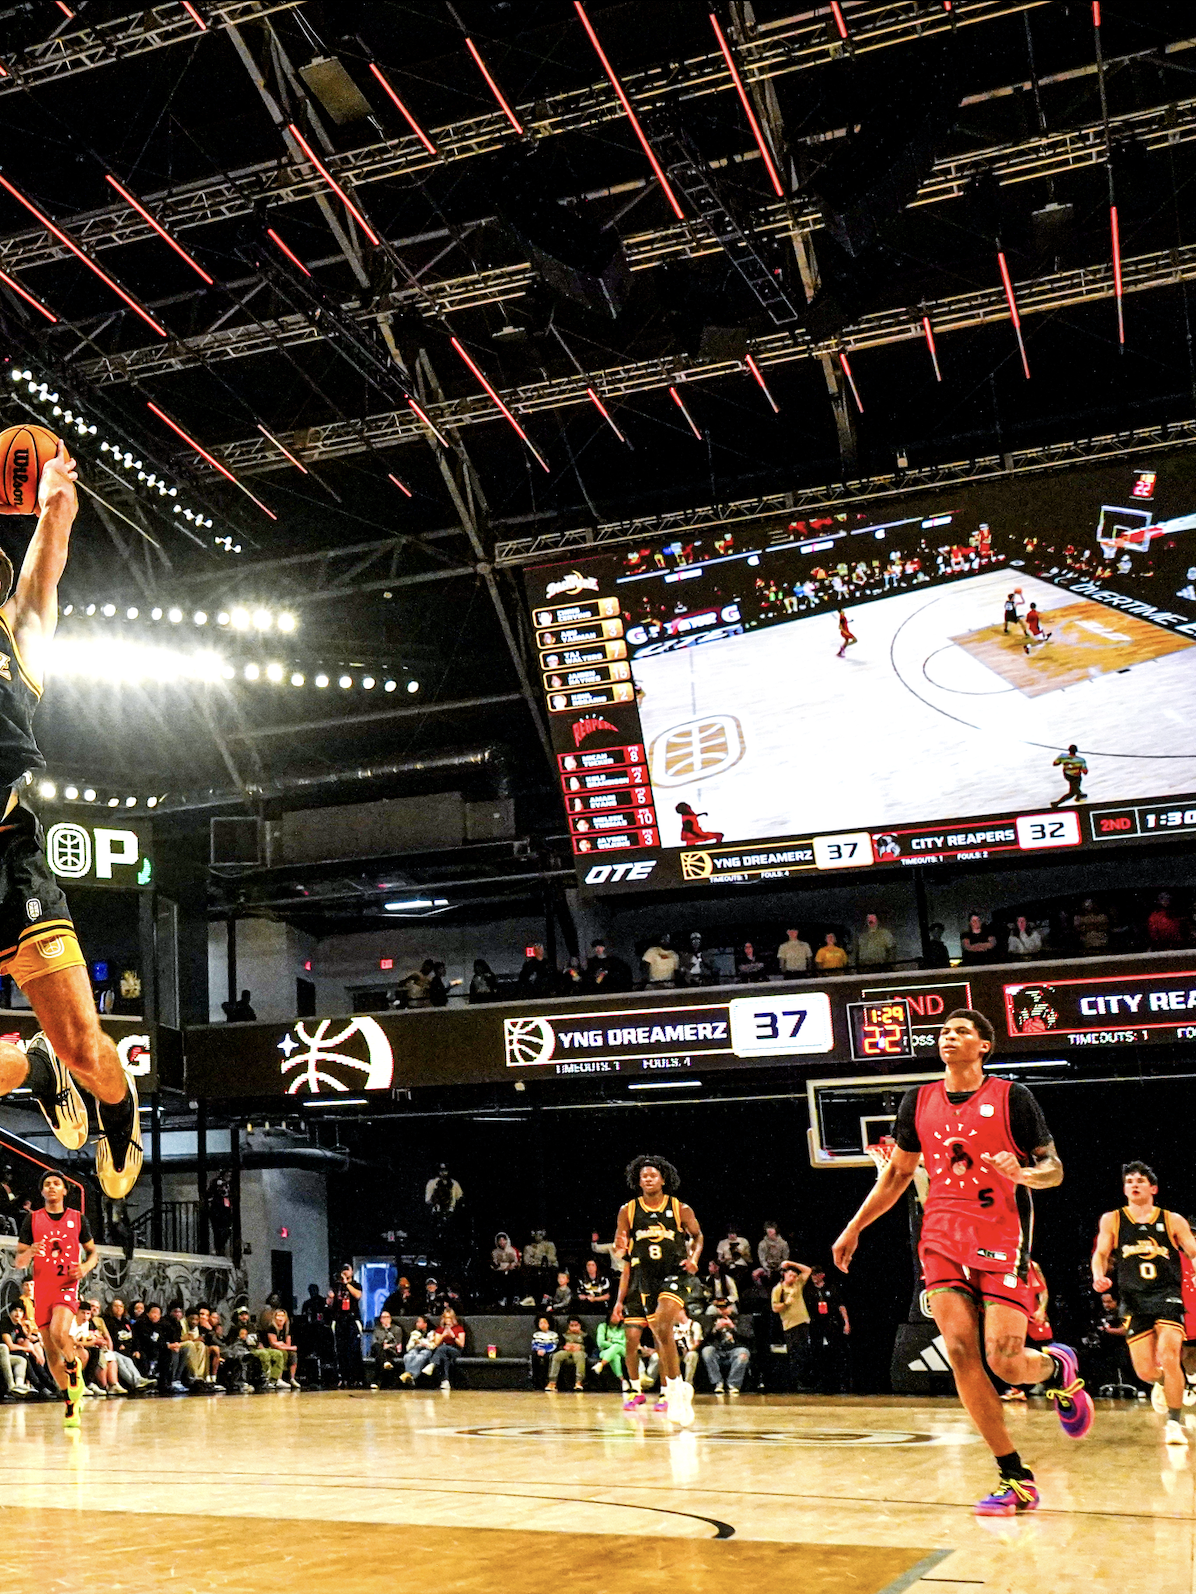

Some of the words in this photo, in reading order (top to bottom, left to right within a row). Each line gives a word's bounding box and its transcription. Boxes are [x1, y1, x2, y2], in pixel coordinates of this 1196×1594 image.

[13, 448, 30, 506] Wilson
[1069, 582, 1189, 626] OVERTIME
[638, 813, 652, 825] 10
[1100, 818, 1131, 832] 2ND
[911, 835, 944, 850] CITY
[947, 829, 1015, 847] REAPERS
[1030, 822, 1066, 840] 32
[713, 856, 741, 869] YNG
[743, 849, 813, 867] DREAMERZ
[827, 842, 859, 860] 37
[900, 855, 937, 866] TIMEOUTS:
[957, 851, 982, 860] FOULS:
[584, 861, 657, 885] OTE
[710, 875, 743, 883] TIMEOUTS:
[893, 994, 944, 1016] ND
[1080, 993, 1143, 1015] CITY
[871, 1006, 904, 1024] 1:29
[558, 1029, 603, 1049] YNG
[607, 1022, 728, 1047] DREAMERZ
[754, 1010, 808, 1040] 37
[862, 1024, 902, 1054] 22
[1067, 1030, 1139, 1046] TIMEOUTS:
[116, 1035, 151, 1076] G
[978, 1188, 995, 1208] 5
[648, 1245, 663, 1260] 8
[1139, 1262, 1158, 1280] 0
